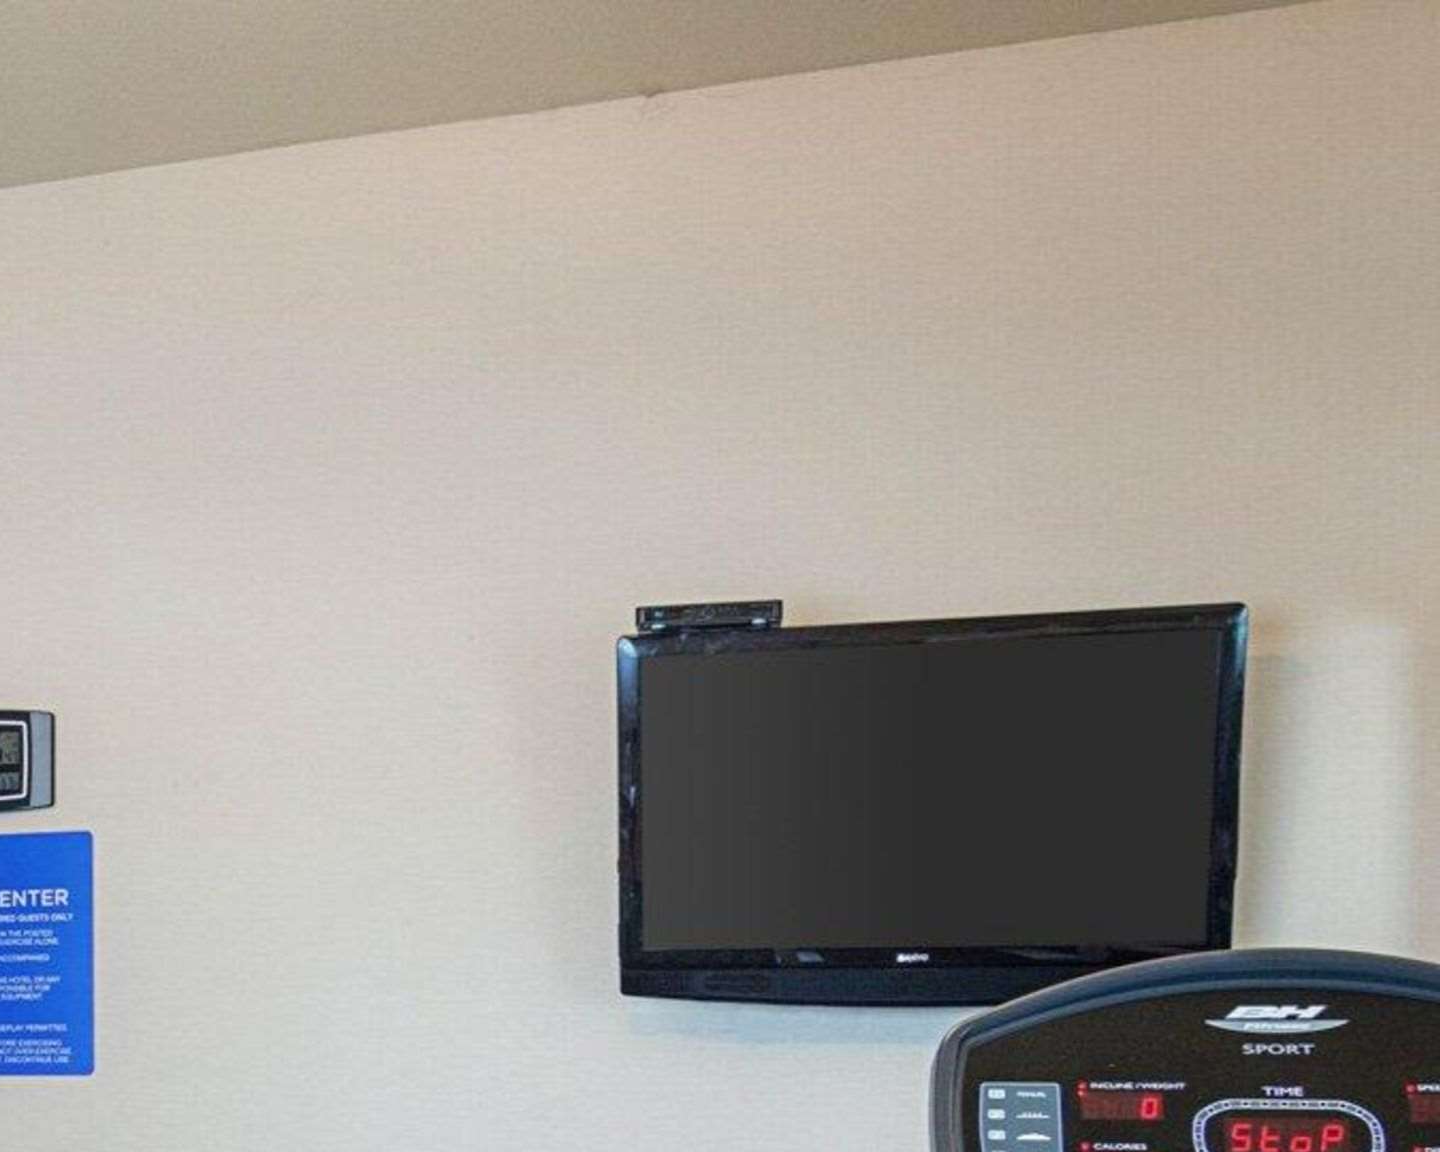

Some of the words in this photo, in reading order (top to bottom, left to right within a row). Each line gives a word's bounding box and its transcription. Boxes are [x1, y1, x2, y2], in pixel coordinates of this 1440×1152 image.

[52, 913, 73, 921] ONLY
[1241, 1043, 1316, 1055] SPORT
[1261, 1085, 1305, 1097] TIME
[1140, 1096, 1161, 1119] 0
[1093, 1142, 1148, 1151] CALORIES
